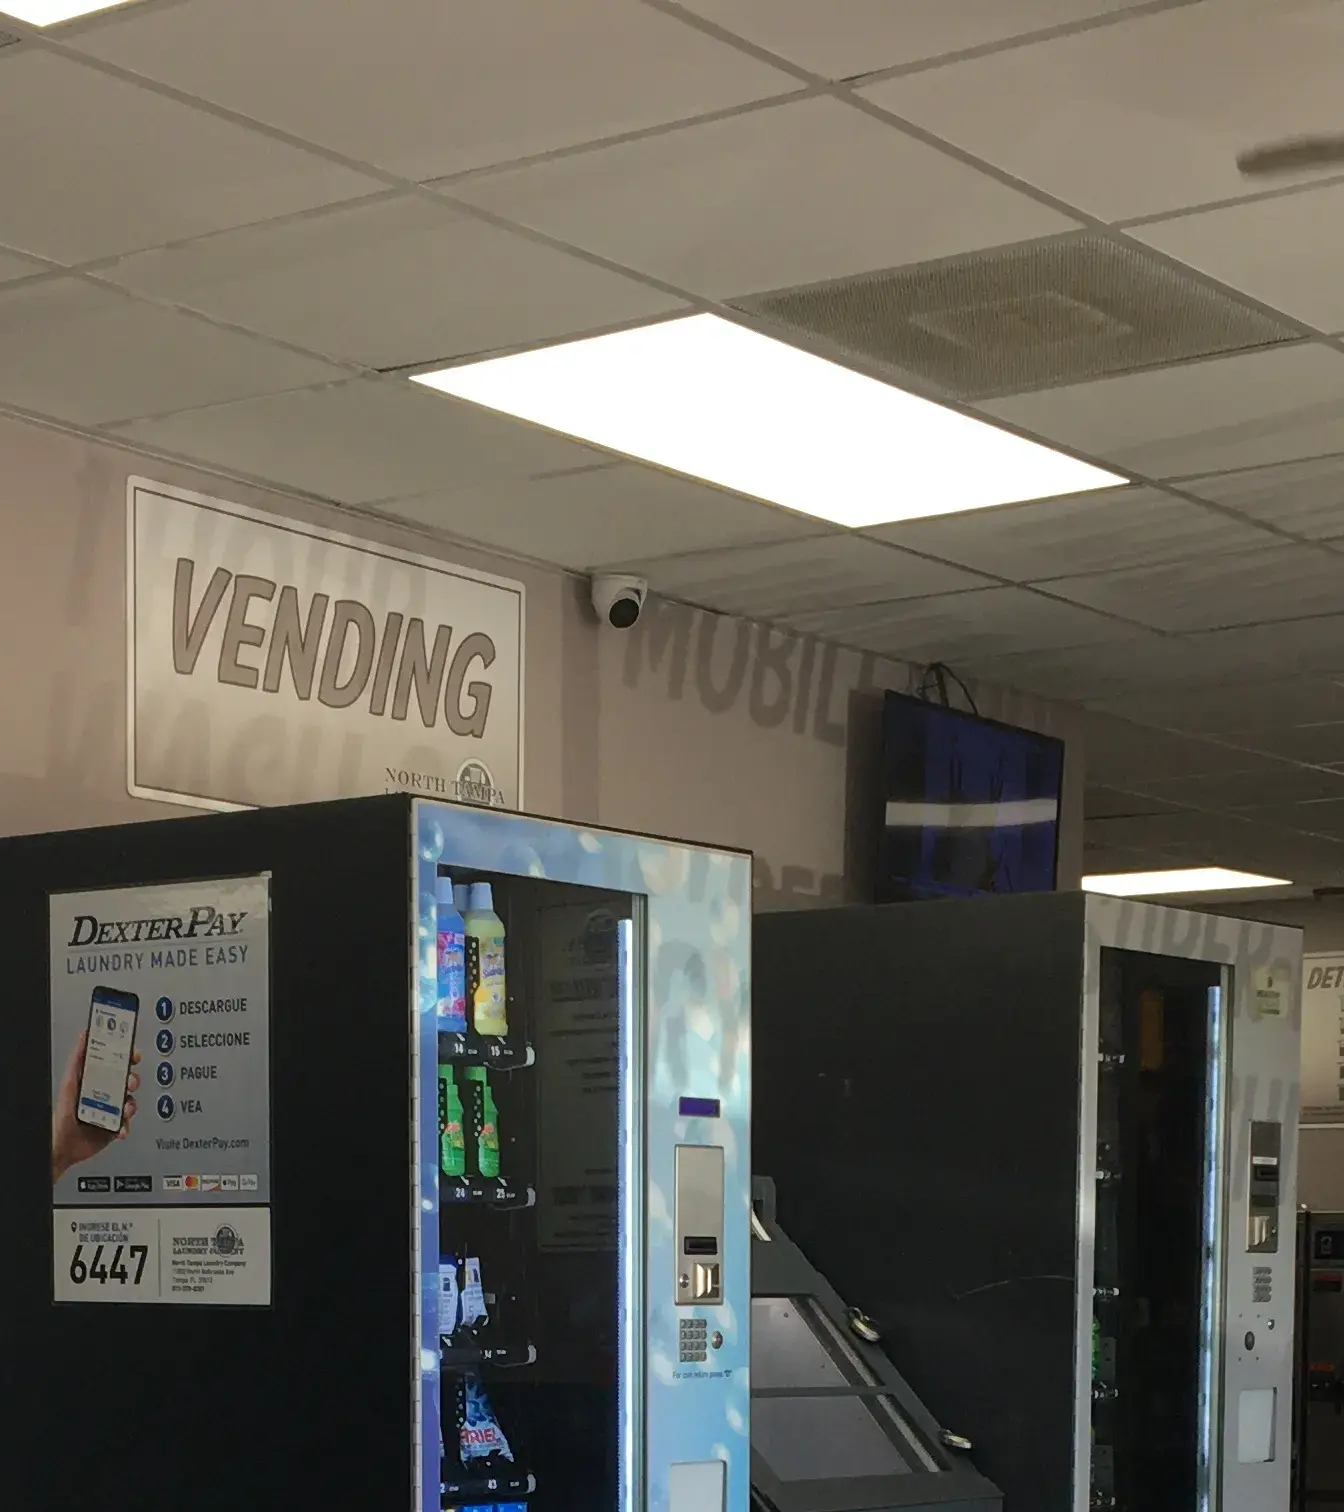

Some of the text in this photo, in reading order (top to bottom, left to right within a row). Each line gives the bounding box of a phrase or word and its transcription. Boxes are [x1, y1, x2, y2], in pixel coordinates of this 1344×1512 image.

[172, 557, 496, 739] VENDING
[385, 767, 505, 805] NORTH TAMPA
[67, 944, 249, 975] LAUNDRY MADE EASY
[161, 998, 247, 1017] 1 DESCARGUE
[161, 1032, 251, 1049] 2 SELECCIONE
[161, 1066, 218, 1081] 3 PAGUE
[161, 1099, 203, 1114] 4 VEA
[156, 1136, 250, 1151] Visite DexterPay.com
[165, 1180, 181, 1188] VISA
[79, 1222, 110, 1232] INGRESE
[173, 1237, 208, 1246] NORTH
[70, 1244, 149, 1285] 6447
[459, 1427, 502, 1445] ARIEL
